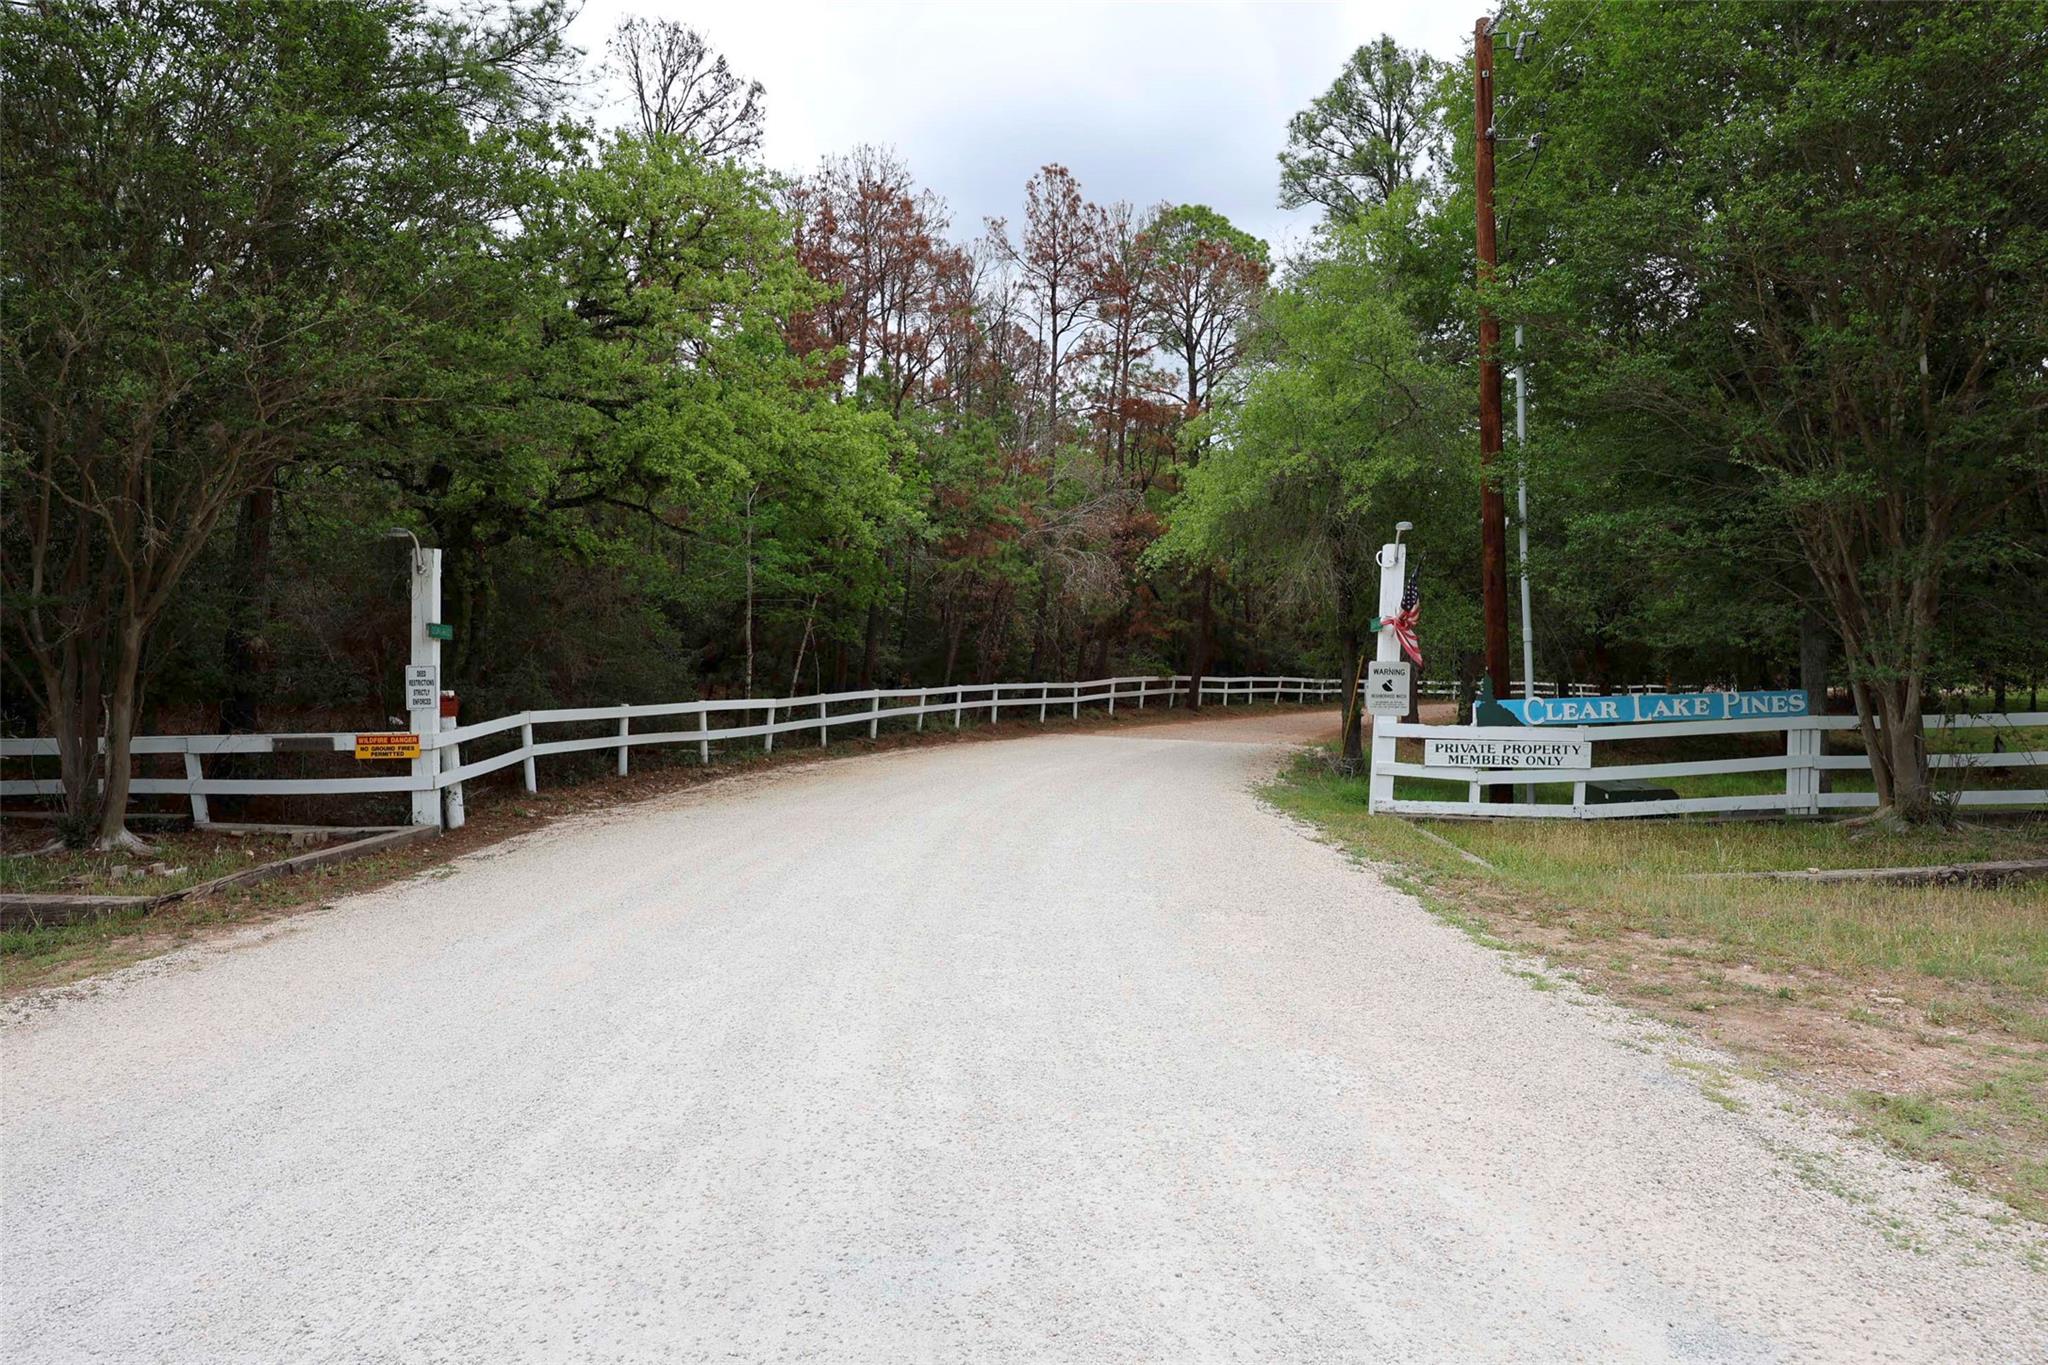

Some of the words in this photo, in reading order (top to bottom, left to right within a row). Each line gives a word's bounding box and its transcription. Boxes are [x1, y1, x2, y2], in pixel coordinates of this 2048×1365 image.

[1373, 668, 1406, 676] WARNING
[1523, 697, 1619, 725] CLEAR
[1632, 693, 1710, 721] LAKE
[1720, 690, 1806, 720] PINES
[358, 736, 388, 744] WILDFIRE
[390, 736, 417, 744] DANGER
[1435, 743, 1496, 754] PRIVATE
[1502, 744, 1581, 755] PROPERTY
[1448, 754, 1519, 765] MEMBERS
[1526, 755, 1564, 766] ONLY
